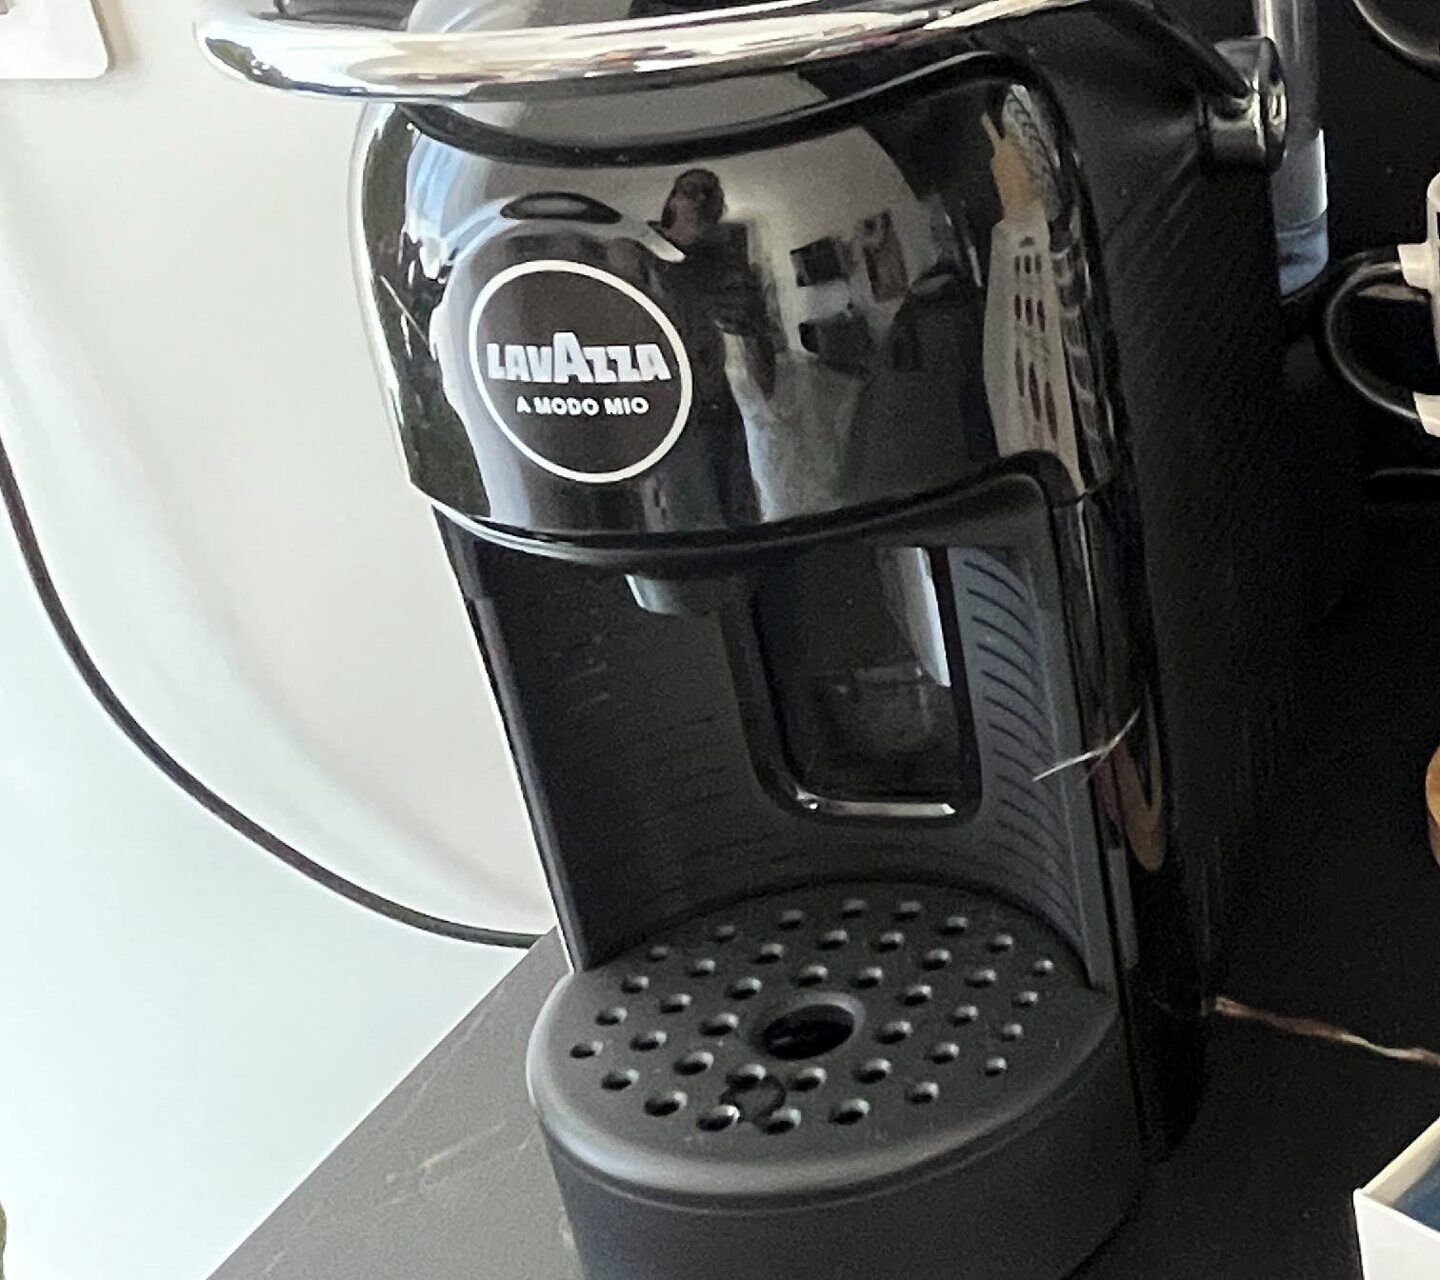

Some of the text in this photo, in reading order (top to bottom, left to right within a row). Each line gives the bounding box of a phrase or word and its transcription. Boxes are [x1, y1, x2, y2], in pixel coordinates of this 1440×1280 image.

[487, 331, 672, 384] LAVAZZA
[517, 396, 650, 416] A MODO MIO
